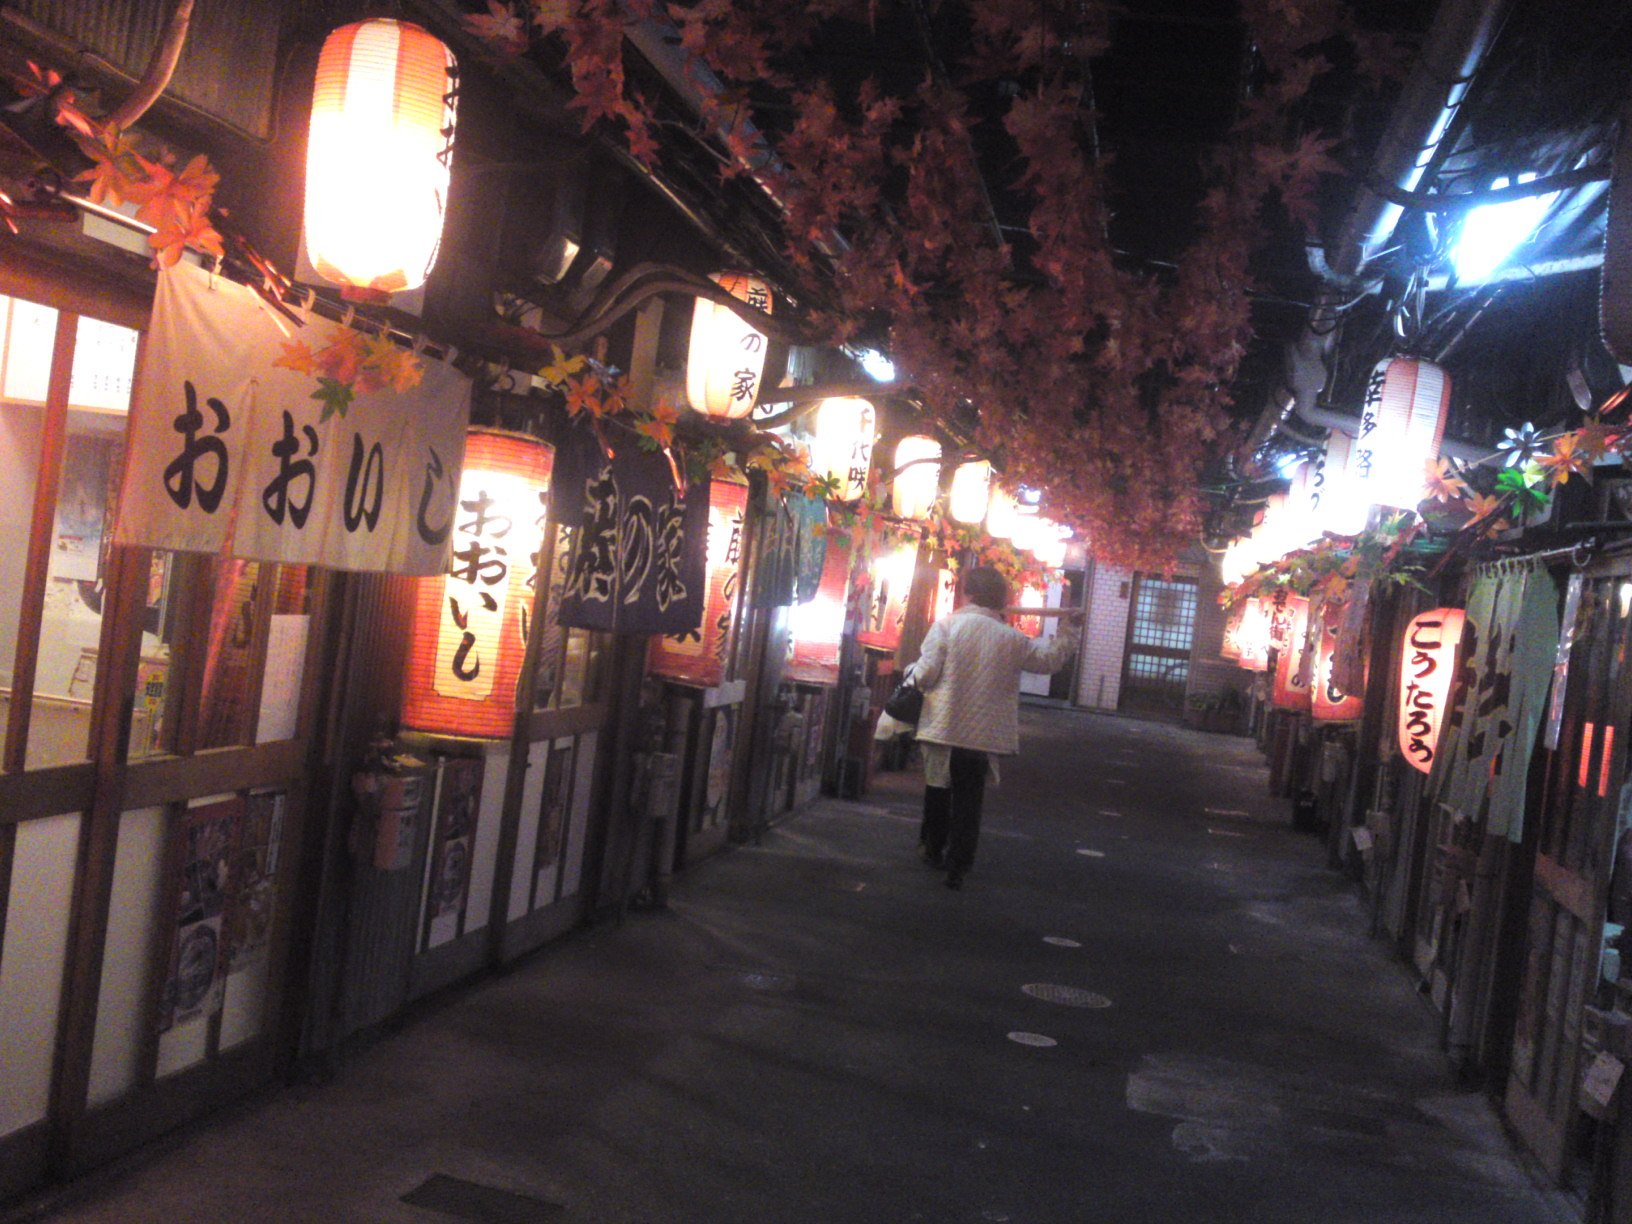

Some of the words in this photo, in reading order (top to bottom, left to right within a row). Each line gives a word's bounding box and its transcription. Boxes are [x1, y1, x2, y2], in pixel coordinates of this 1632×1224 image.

[163, 380, 455, 547] おおいし
[451, 490, 513, 682] おおいし
[1405, 620, 1442, 763] こうたろう
